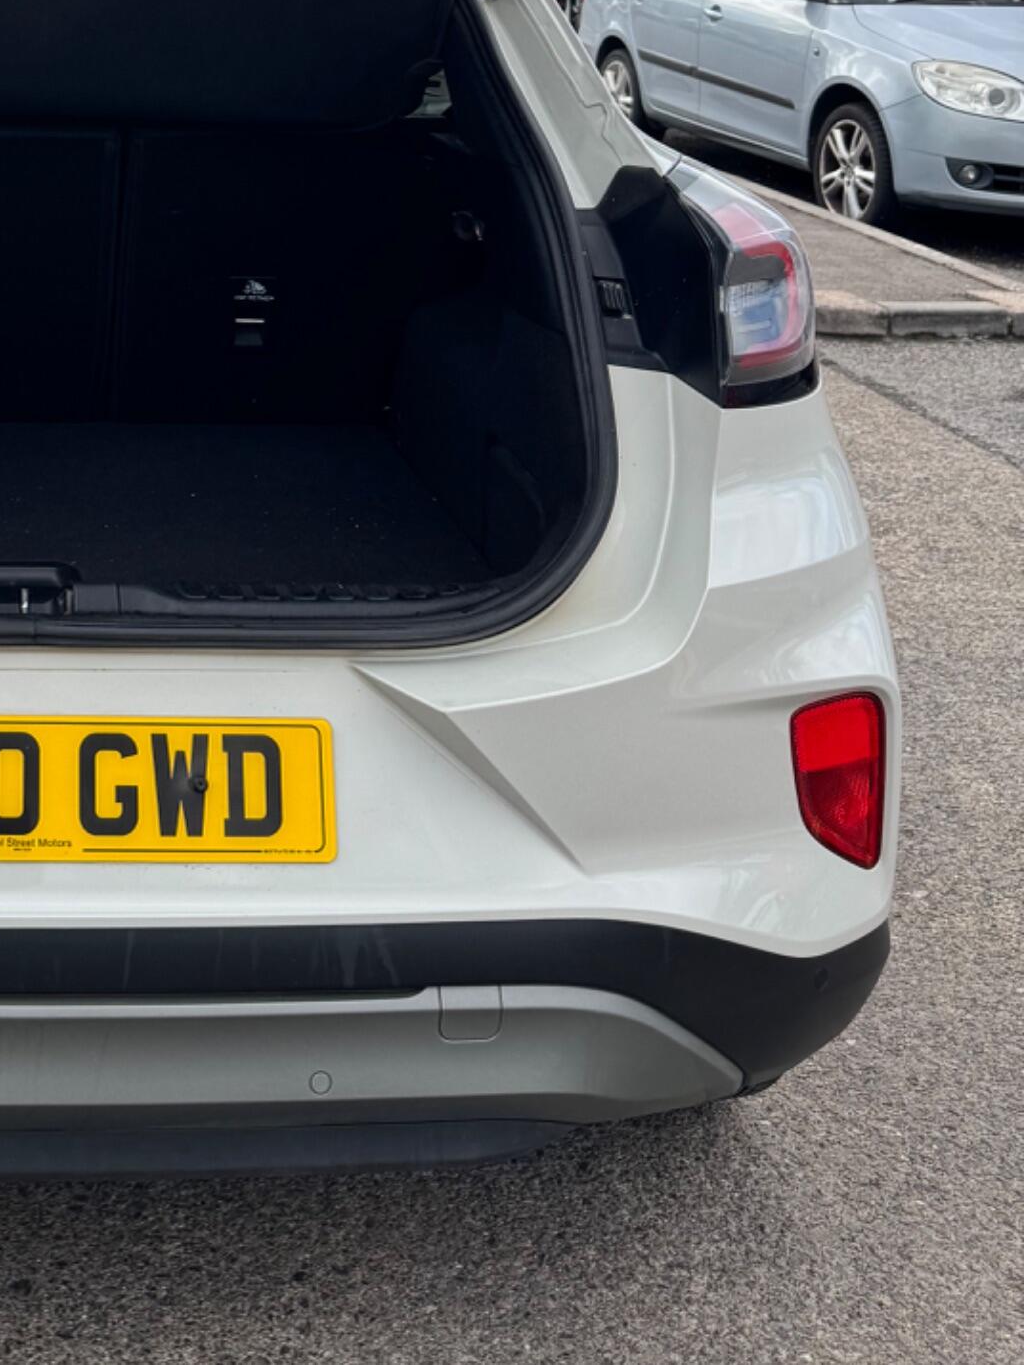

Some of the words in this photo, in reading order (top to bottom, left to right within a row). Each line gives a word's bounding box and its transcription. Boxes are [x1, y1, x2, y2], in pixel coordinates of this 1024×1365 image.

[79, 732, 283, 838] GWD
[6, 837, 36, 848] Street
[37, 838, 72, 848] Motors
